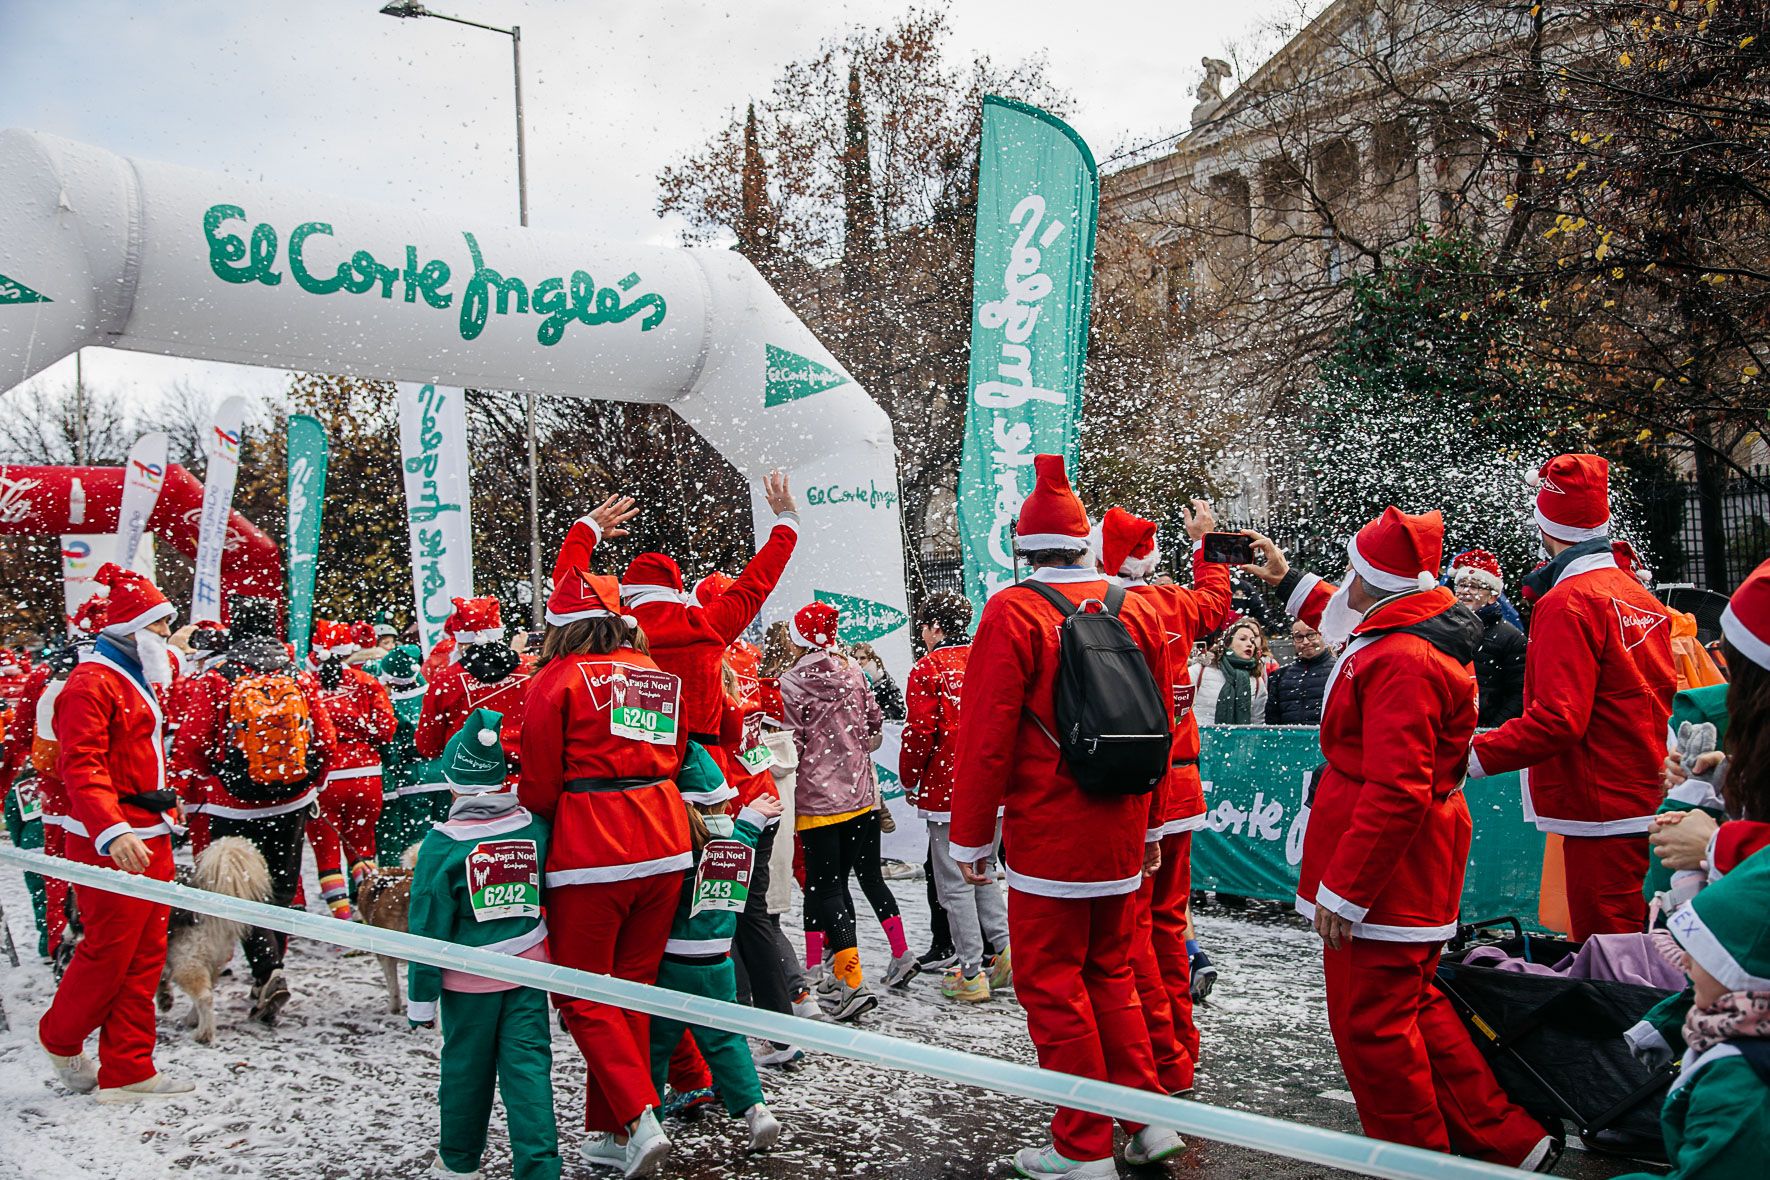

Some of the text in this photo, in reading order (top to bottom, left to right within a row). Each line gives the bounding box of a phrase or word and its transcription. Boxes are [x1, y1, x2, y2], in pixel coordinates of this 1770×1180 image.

[202, 204, 667, 346] El Corte Inglés
[827, 485, 868, 504] Corte
[629, 679, 672, 691] Papá Noel
[494, 851, 537, 863] Papá Noel
[726, 851, 746, 860] Noel
[484, 884, 526, 906] 6242
[844, 952, 859, 973] RU
